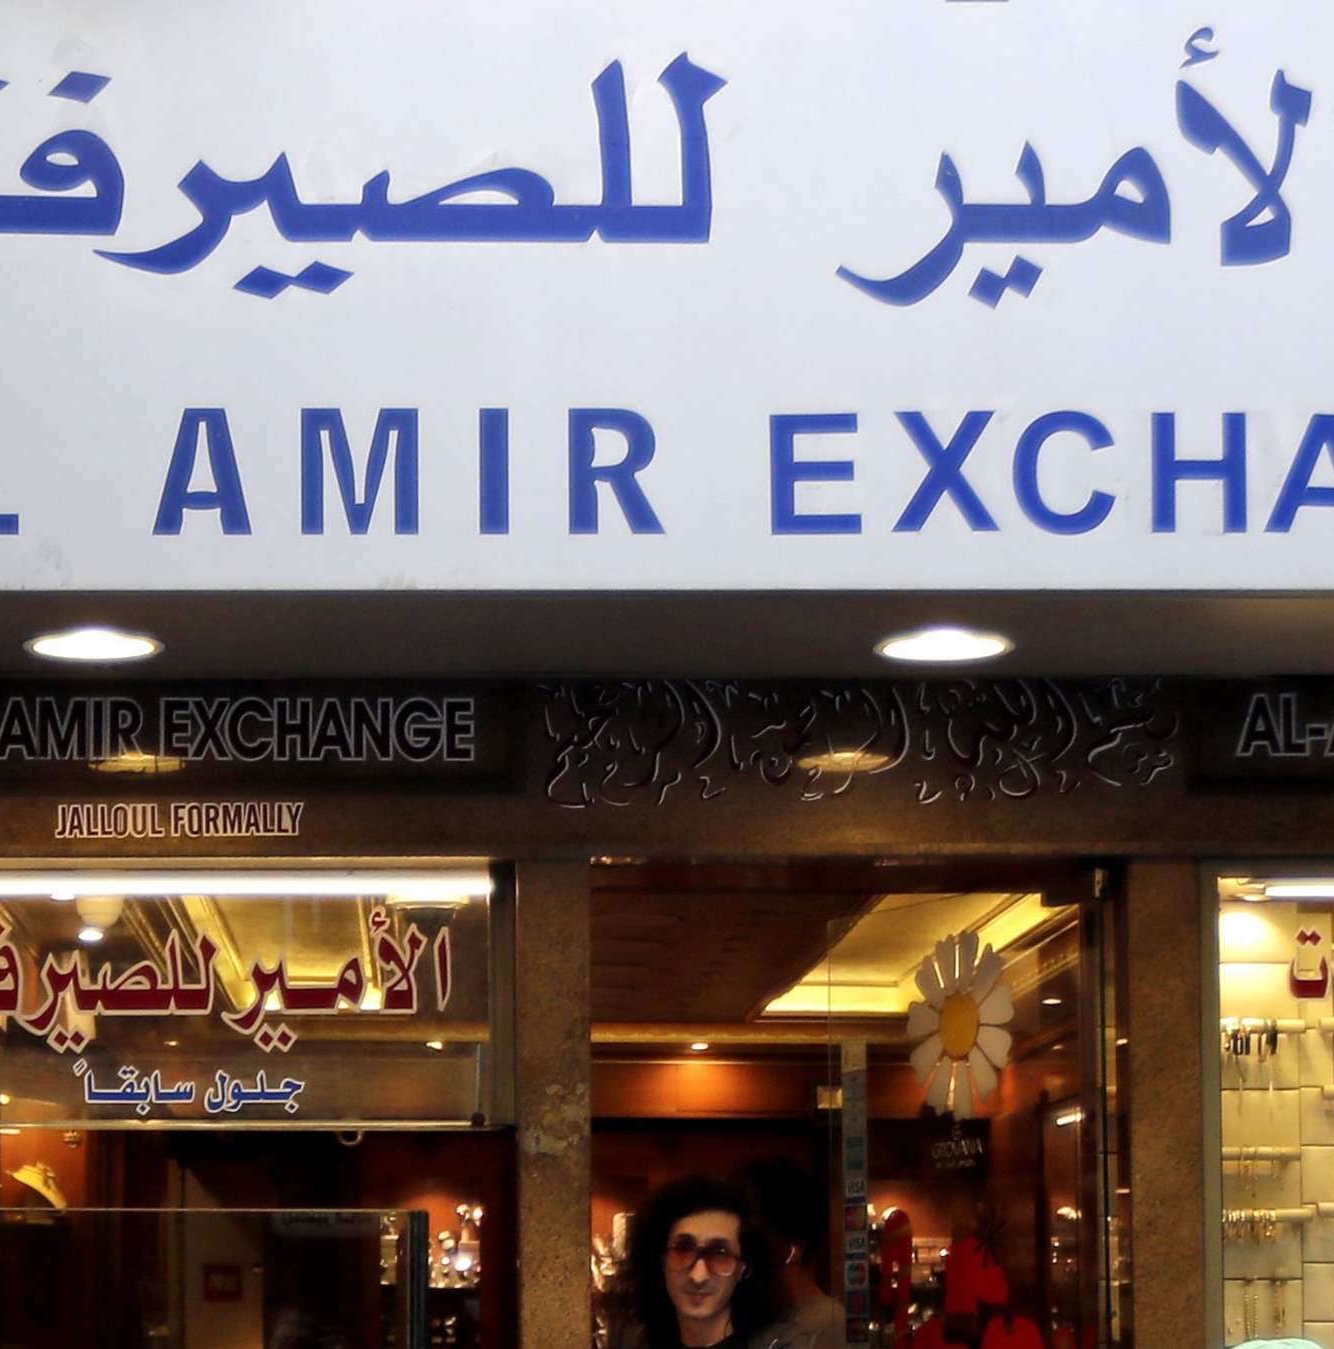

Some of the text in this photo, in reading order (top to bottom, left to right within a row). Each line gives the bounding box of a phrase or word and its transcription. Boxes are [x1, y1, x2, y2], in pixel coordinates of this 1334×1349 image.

[152, 407, 667, 536] AMIR
[161, 697, 475, 761] EXCHANGE
[54, 802, 304, 839] JALLOUL FORMALLY
[222, 905, 452, 1053] الأمير
[204, 1069, 305, 1114] جلول
